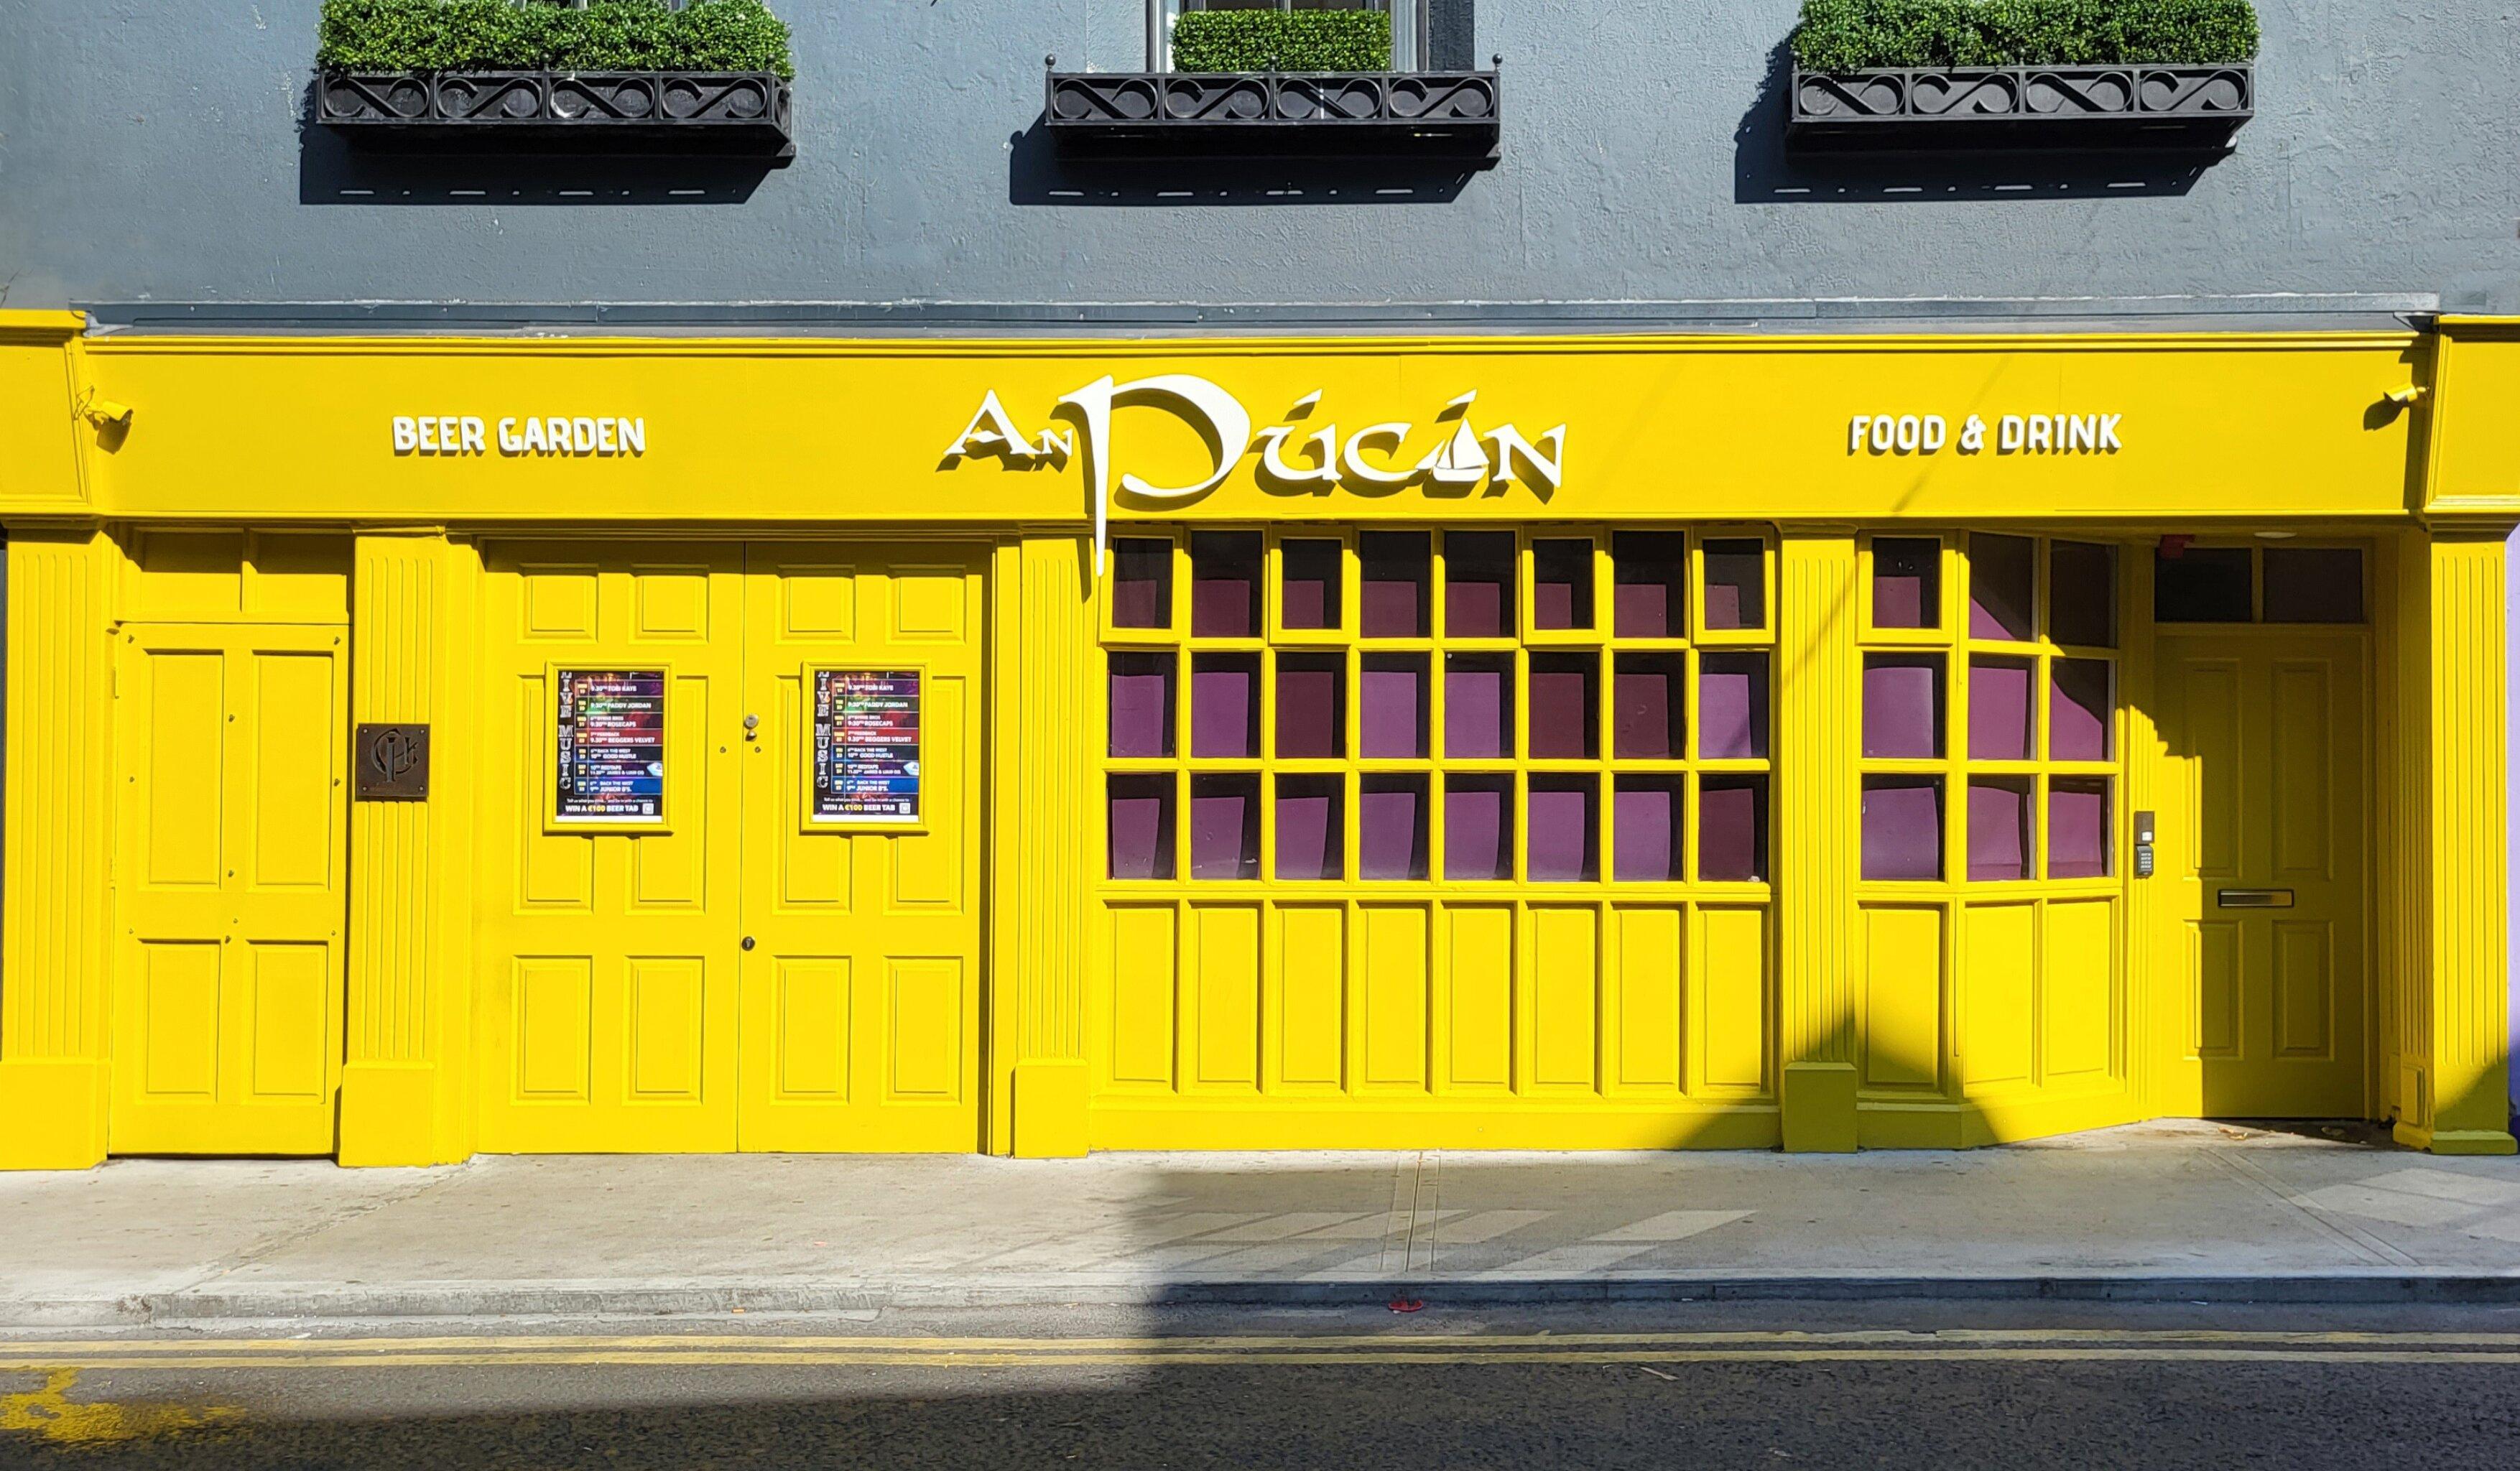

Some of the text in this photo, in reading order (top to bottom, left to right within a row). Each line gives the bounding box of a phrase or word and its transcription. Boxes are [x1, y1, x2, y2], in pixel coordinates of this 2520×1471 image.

[392, 416, 647, 453] BEER GARDEN
[1850, 413, 2123, 450] FOOD & DRINK
[558, 724, 574, 789] MUSIC
[815, 723, 831, 788] MUSIC
